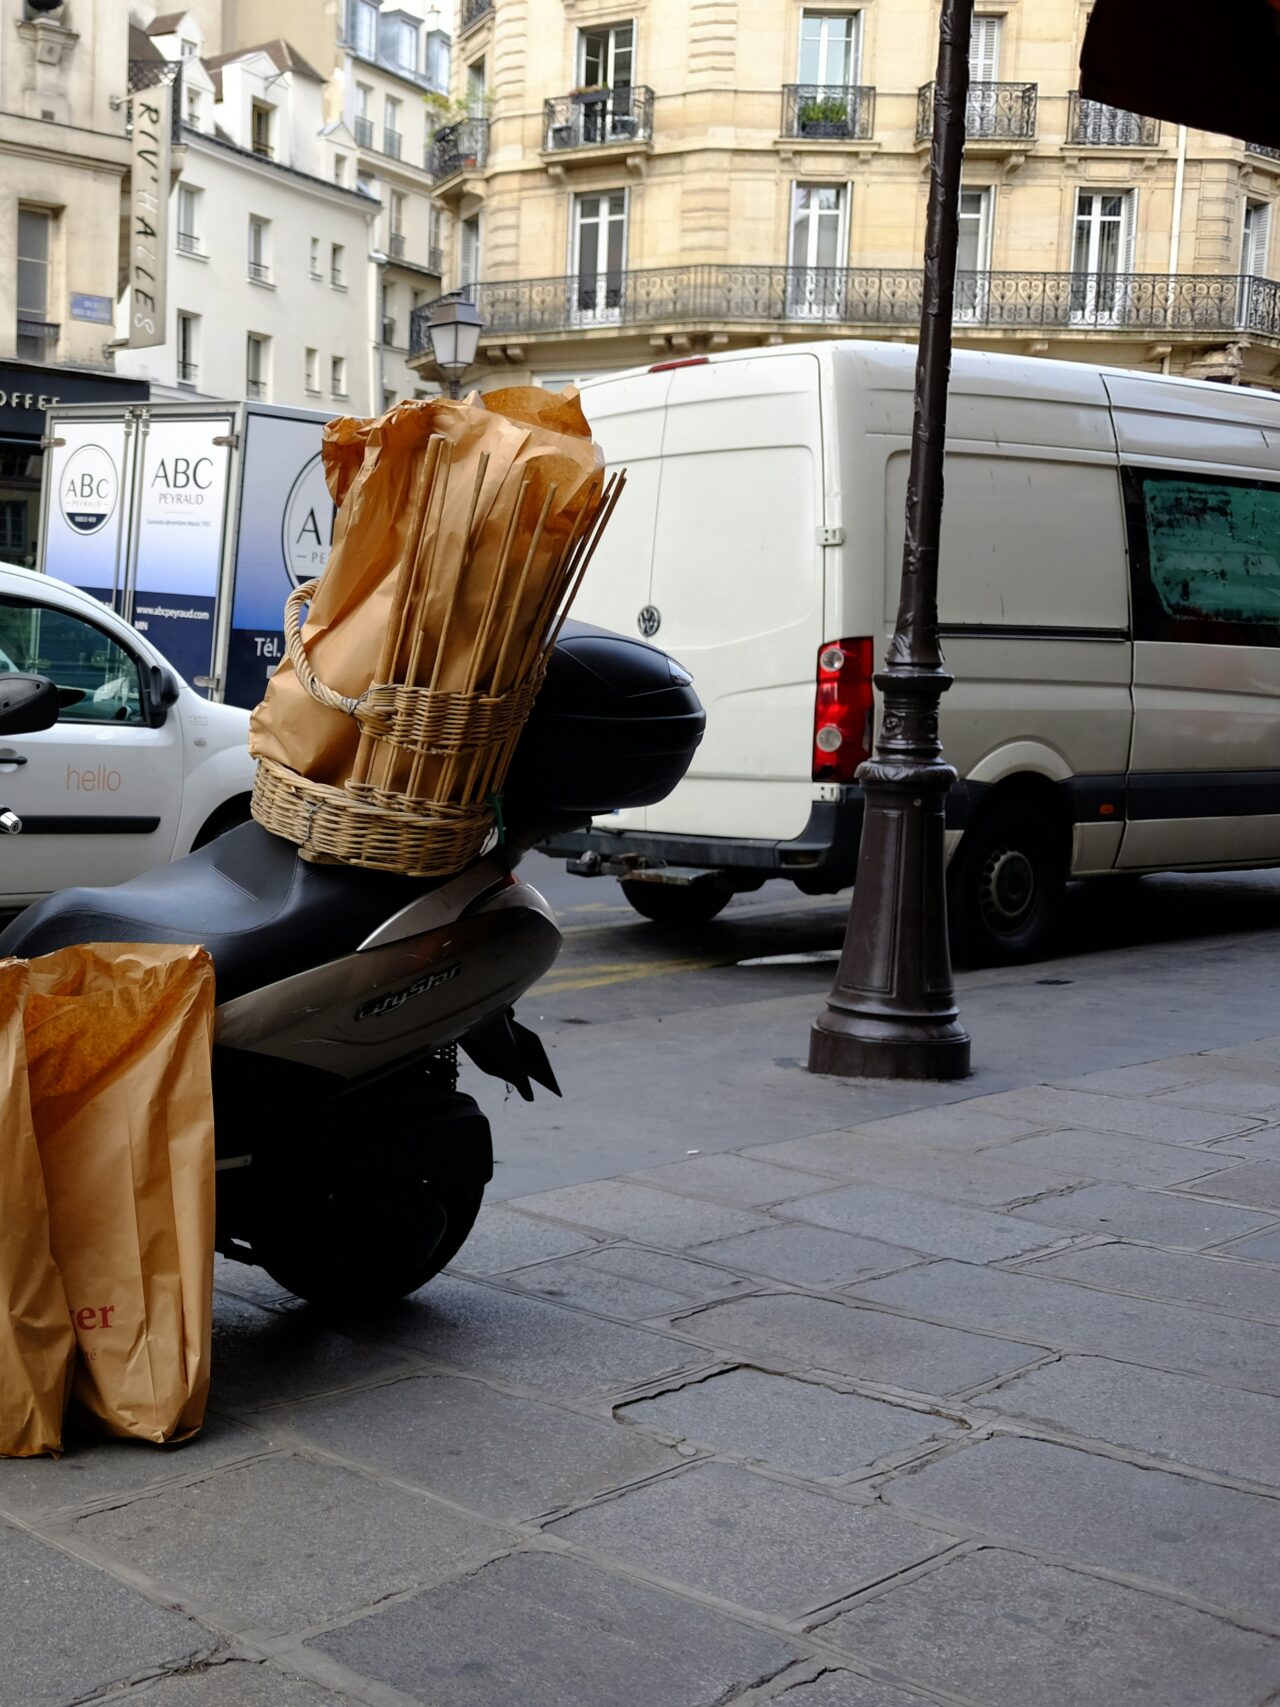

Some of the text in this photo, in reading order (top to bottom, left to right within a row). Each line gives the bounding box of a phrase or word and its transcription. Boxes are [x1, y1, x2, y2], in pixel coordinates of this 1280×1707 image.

[65, 473, 110, 499] ABC
[150, 457, 215, 490] ABC
[158, 493, 205, 506] PEYRAUD
[135, 605, 210, 621] www.abcpeyraud.com
[254, 637, 282, 657] Tél.
[67, 764, 122, 792] hello
[72, 1304, 115, 1331] er
